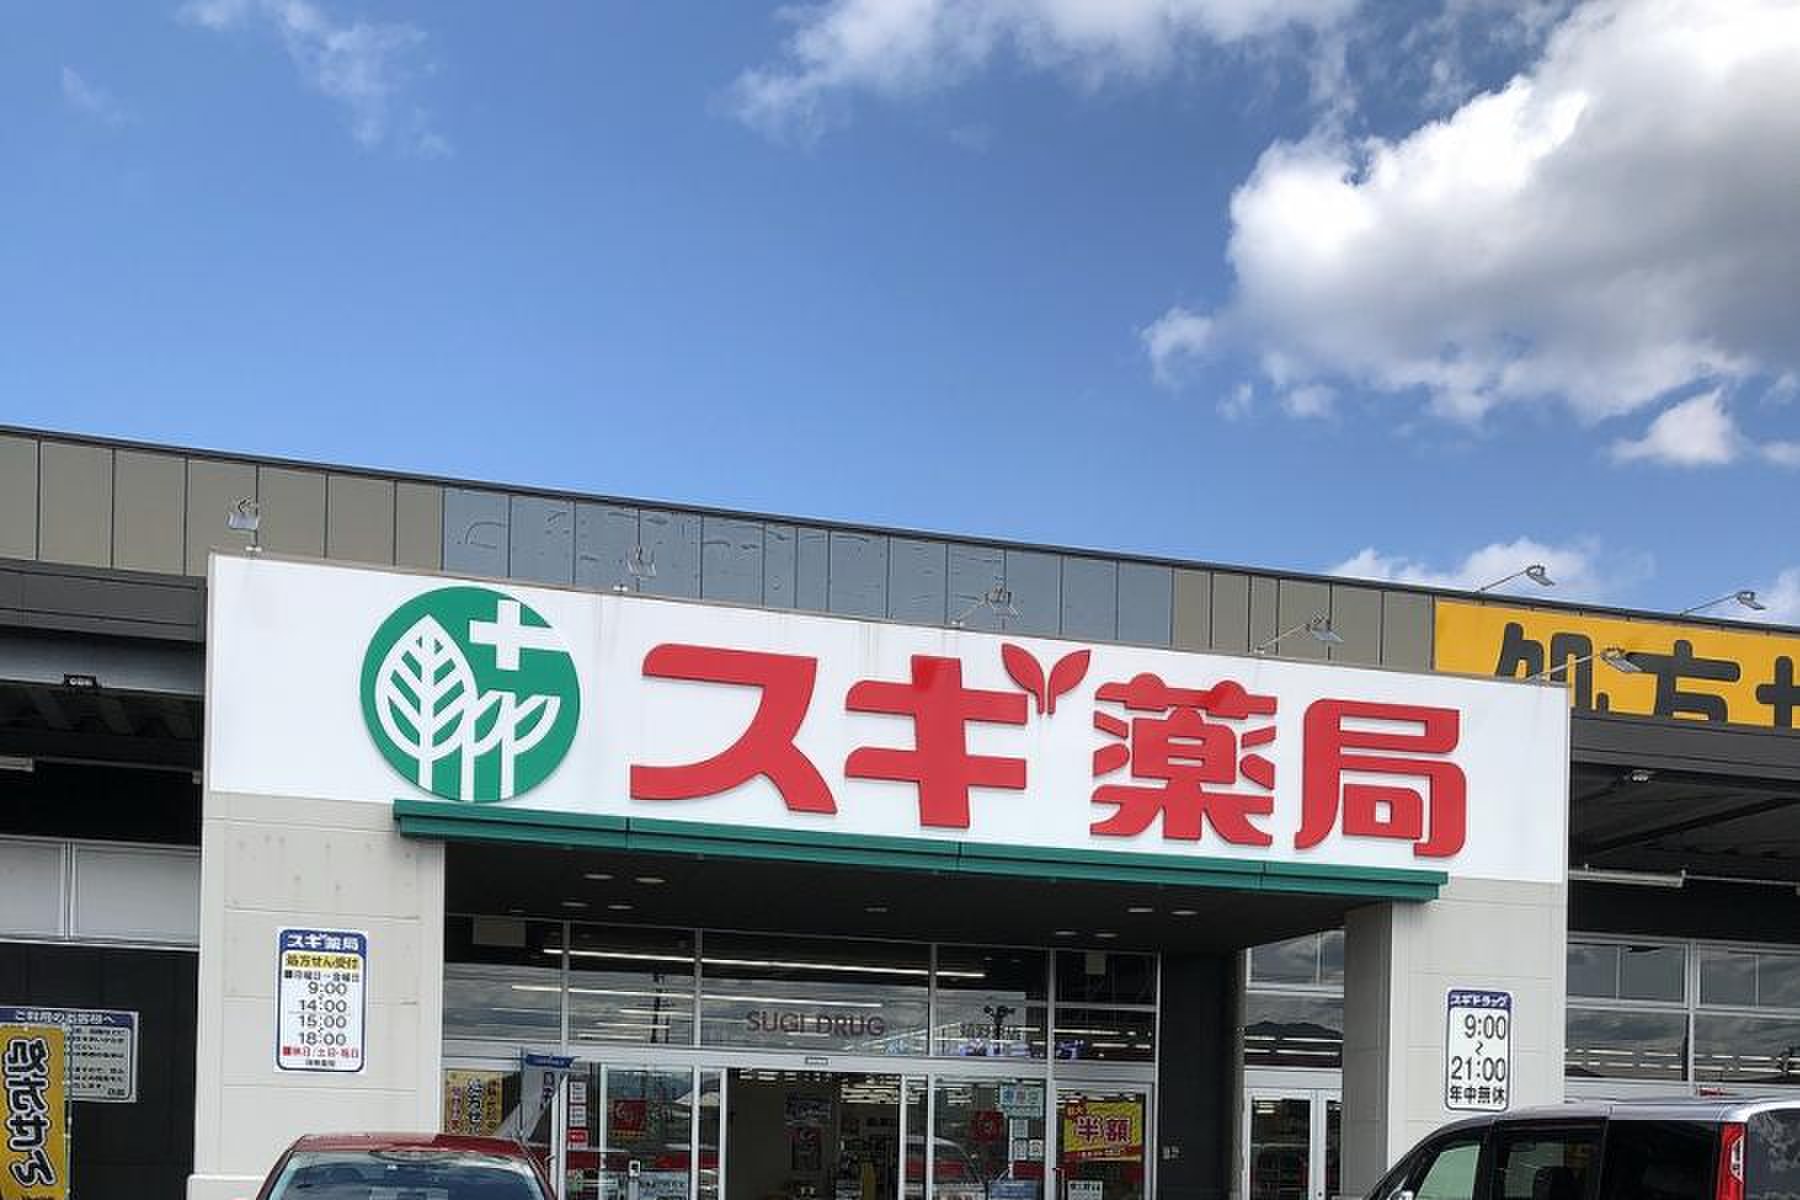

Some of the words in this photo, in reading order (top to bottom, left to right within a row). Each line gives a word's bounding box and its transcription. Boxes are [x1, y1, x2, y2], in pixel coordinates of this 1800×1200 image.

[630, 643, 1466, 858] スギ薬局
[287, 933, 359, 951] スギ薬局
[308, 981, 347, 995] 9:00
[300, 999, 347, 1013] 14:00
[300, 1014, 347, 1029] 15:00
[747, 1010, 804, 1033] SUGI
[817, 1015, 885, 1036] DRUG
[1464, 1013, 1506, 1041] 9:00
[300, 1032, 347, 1046] 18:00
[1451, 1055, 1506, 1083] 21:00
[1449, 1085, 1505, 1105] 年中無休
[1076, 1115, 1131, 1144] 半額
